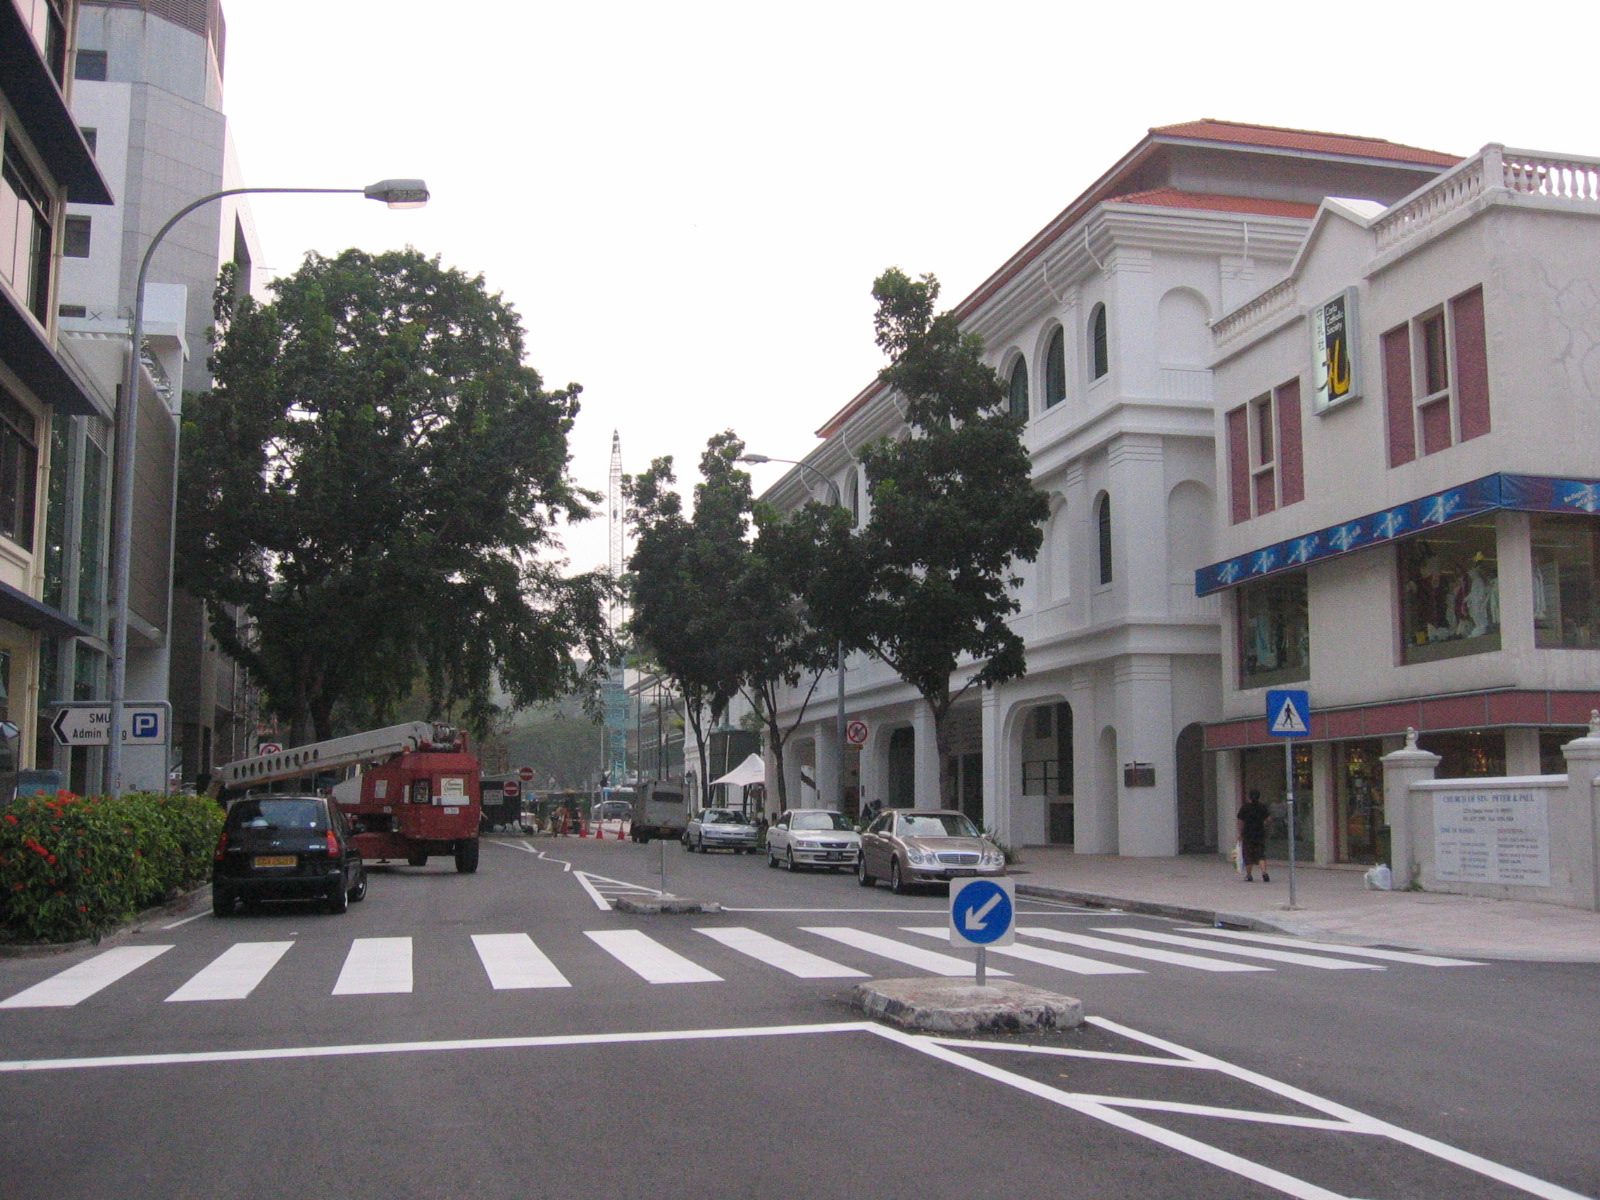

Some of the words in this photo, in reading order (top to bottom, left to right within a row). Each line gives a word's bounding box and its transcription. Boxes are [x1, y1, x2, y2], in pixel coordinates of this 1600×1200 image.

[1326, 322, 1343, 336] Society
[90, 713, 112, 723] SMU
[135, 716, 155, 735] P
[72, 728, 102, 739] Admin
